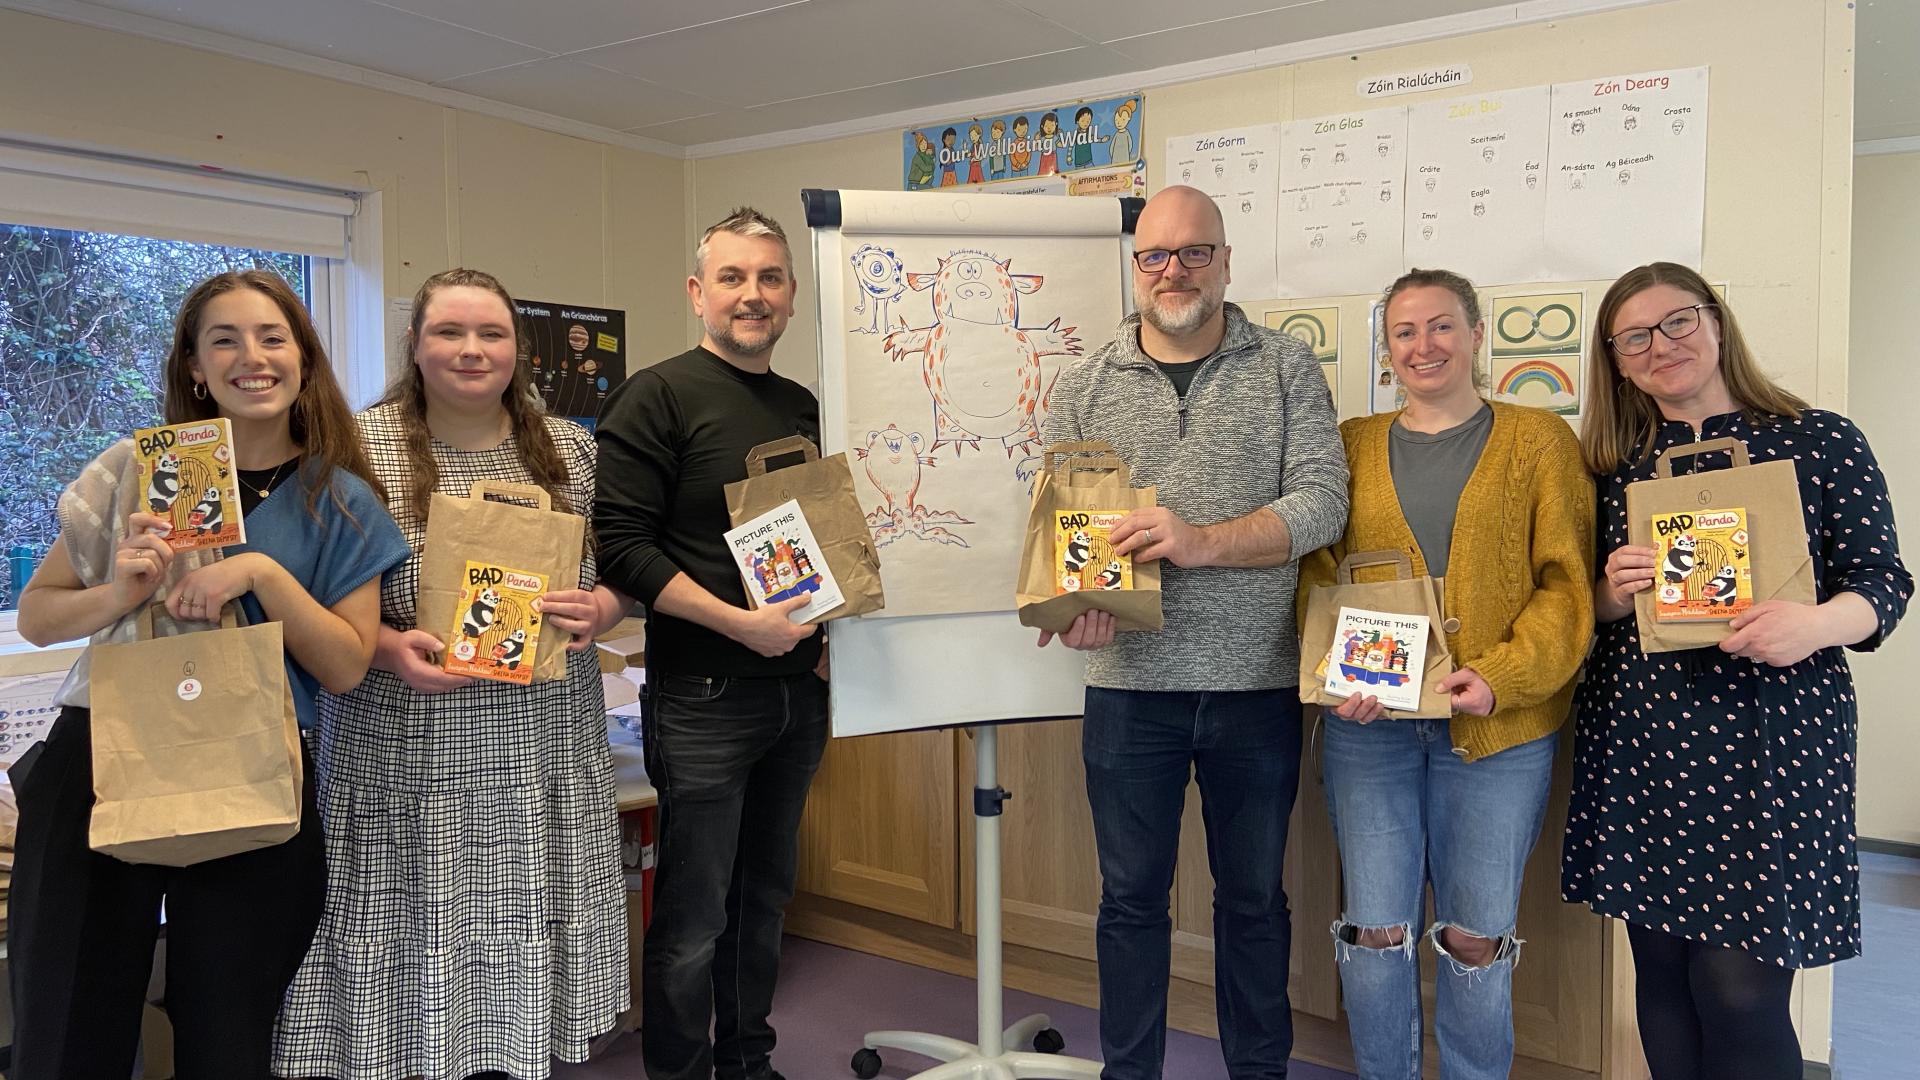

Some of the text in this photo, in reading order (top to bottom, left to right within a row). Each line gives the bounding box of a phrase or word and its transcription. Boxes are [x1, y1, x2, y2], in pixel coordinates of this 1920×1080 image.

[1367, 69, 1461, 94] Zóin Rialúcháin
[1594, 76, 1670, 96] Zón Dearg
[1314, 117, 1364, 134] Zón Glas
[939, 125, 1099, 164] Our Wellbeing Wall
[1196, 137, 1246, 152] Zón Gorm
[1605, 160, 1616, 169] Ag
[1078, 174, 1118, 185] AFFIRMATIONS
[526, 306, 551, 317] System
[561, 310, 571, 319] An
[139, 429, 176, 457] BAD
[178, 427, 218, 443] Panda
[1060, 513, 1090, 530] BAD
[1656, 514, 1737, 536] BAD Panda
[734, 513, 796, 548] PICTURE THIS
[469, 567, 540, 589] BAD Panda
[1345, 615, 1419, 630] PICTURE THIS
